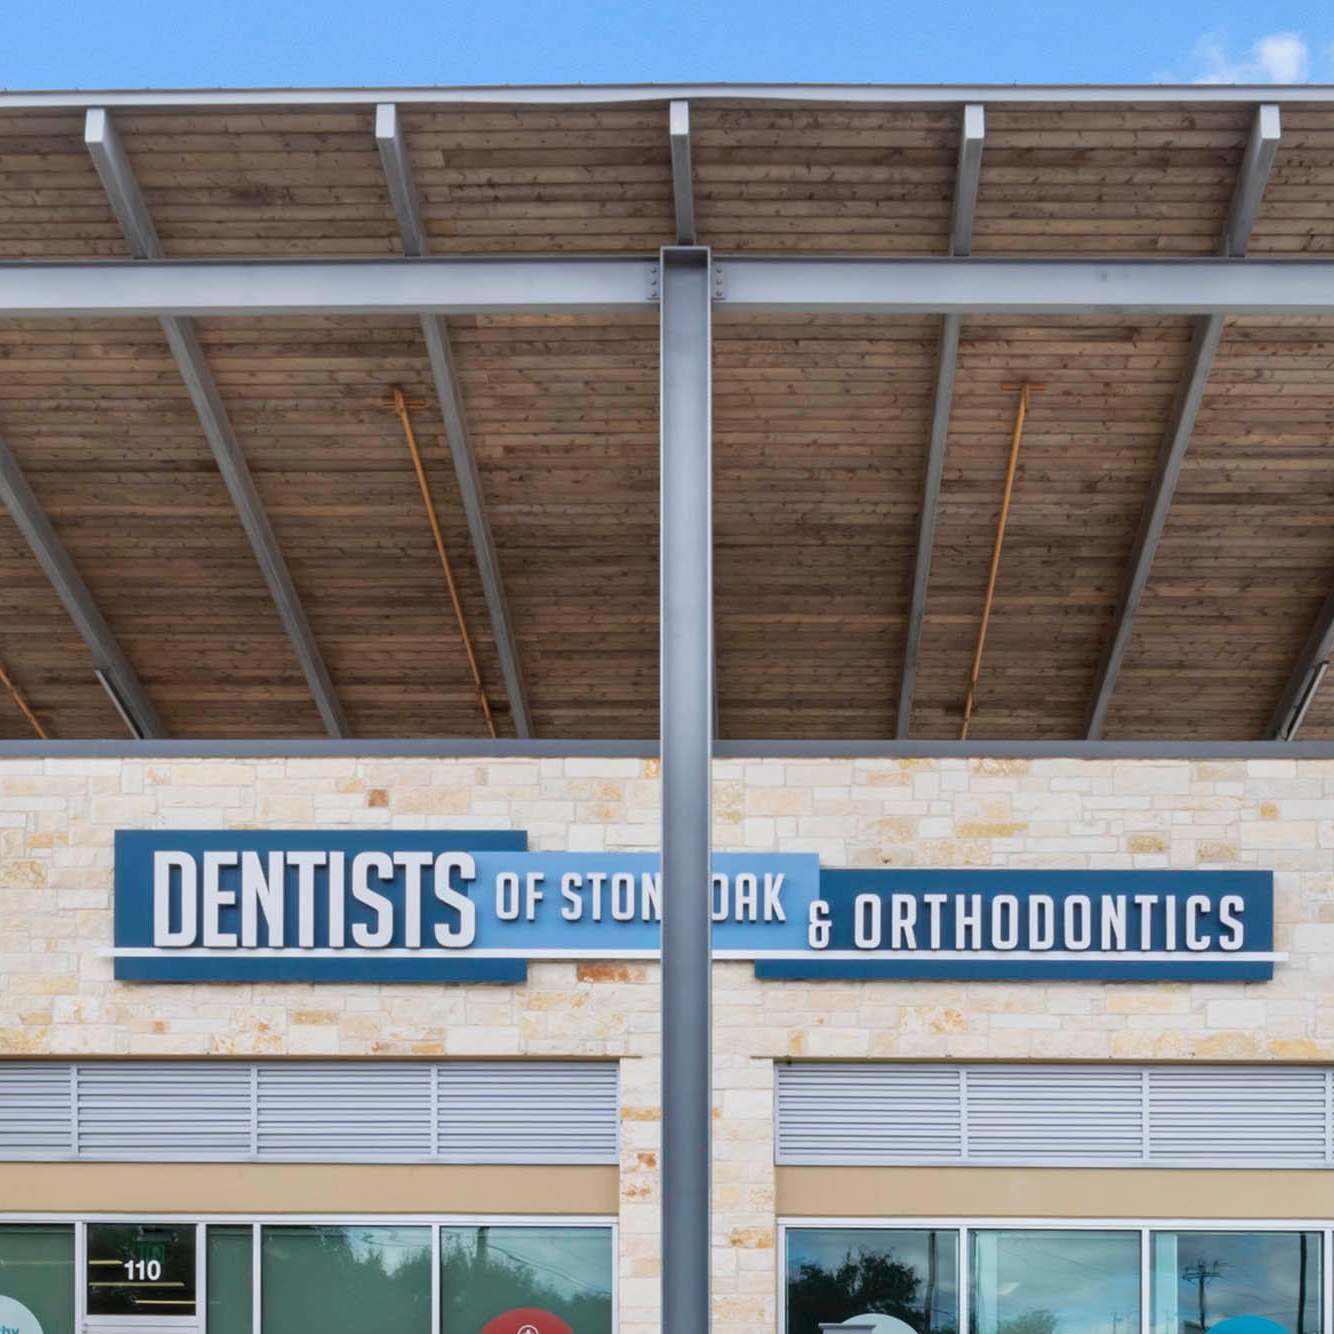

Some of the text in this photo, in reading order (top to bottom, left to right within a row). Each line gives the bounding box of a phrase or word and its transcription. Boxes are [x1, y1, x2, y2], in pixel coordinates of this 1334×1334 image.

[154, 851, 476, 948] DENTISTS
[495, 872, 544, 921] OF
[561, 872, 662, 922] STON
[808, 898, 832, 950] &
[854, 893, 1246, 951] ORTHODONTICS
[124, 1260, 162, 1281] 110
